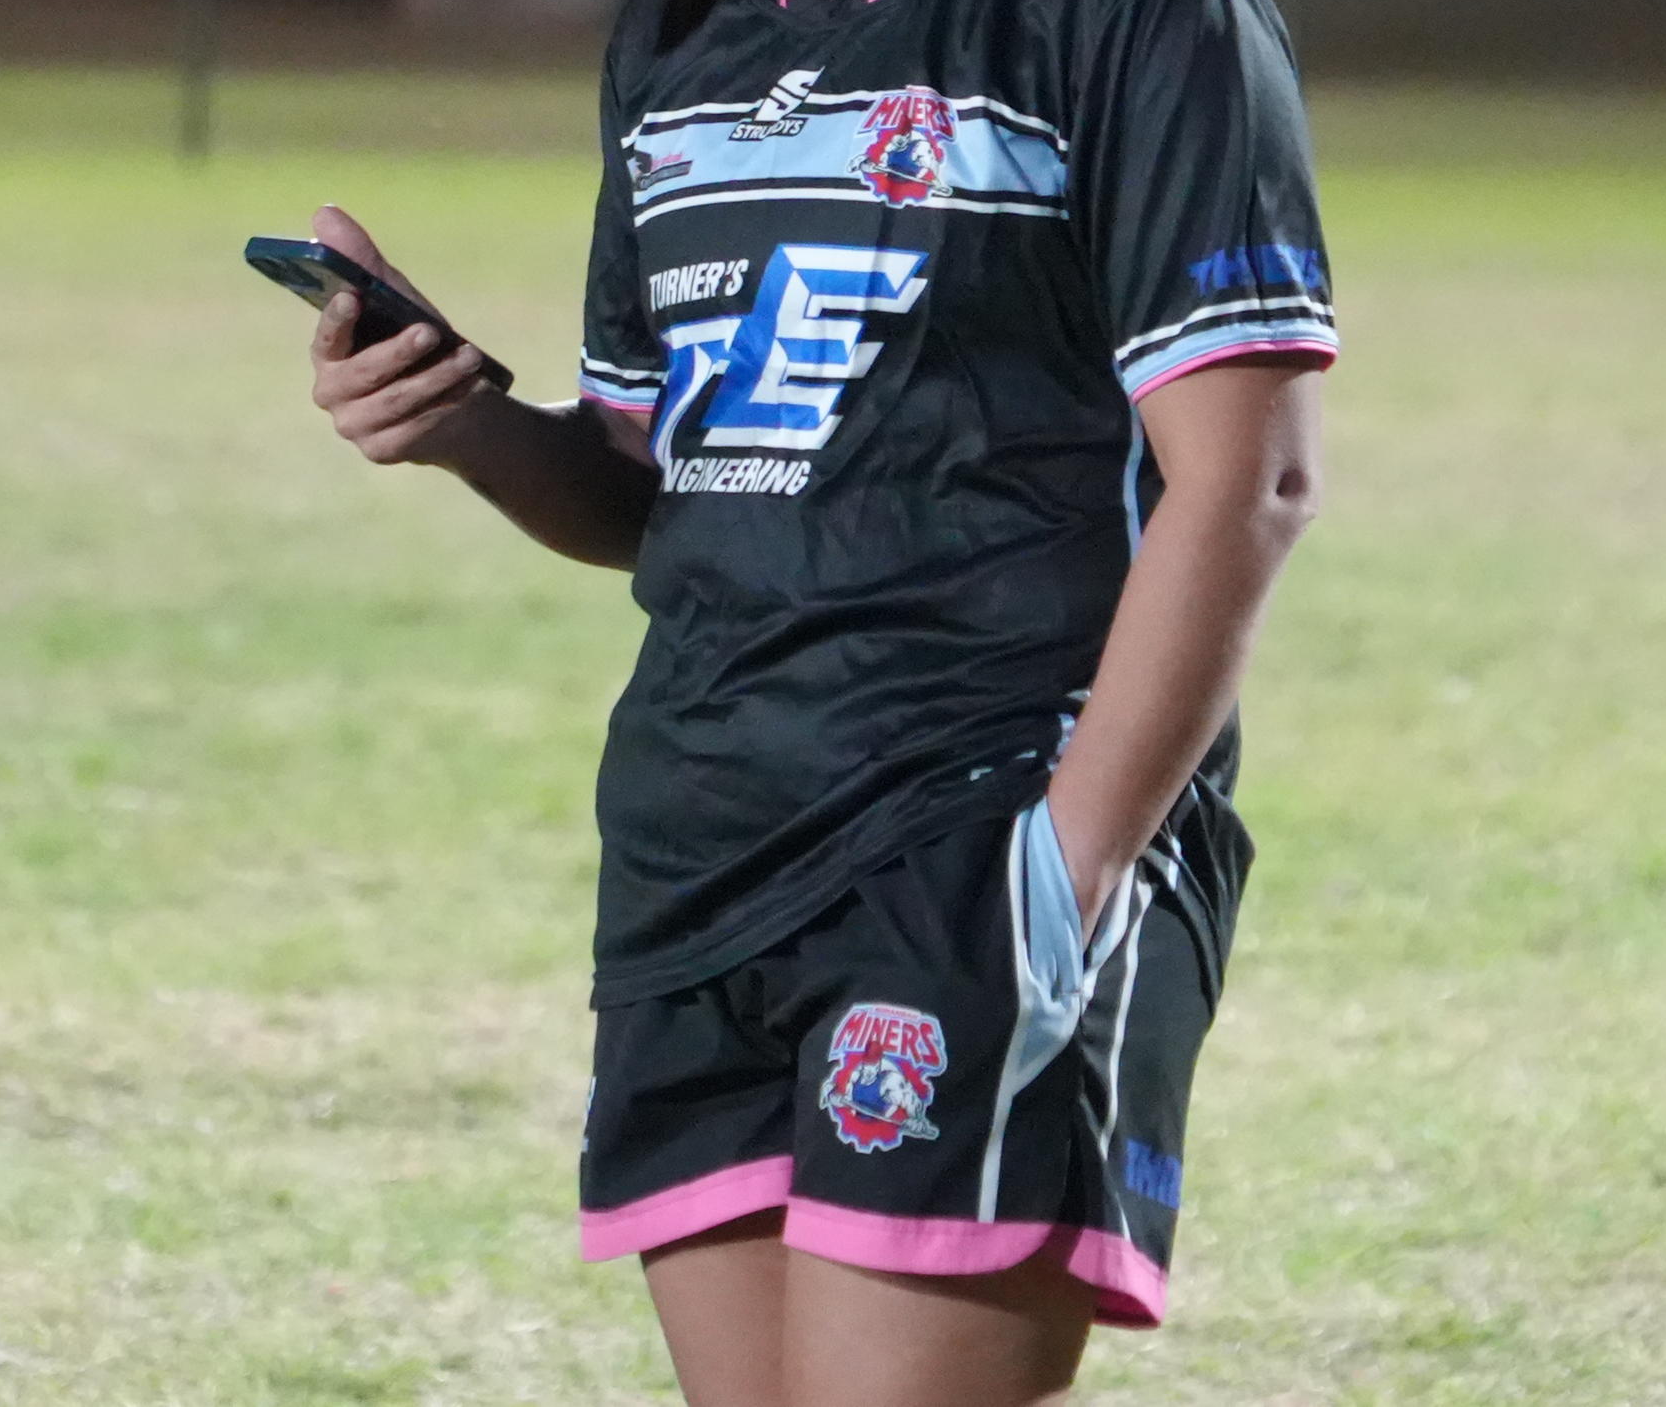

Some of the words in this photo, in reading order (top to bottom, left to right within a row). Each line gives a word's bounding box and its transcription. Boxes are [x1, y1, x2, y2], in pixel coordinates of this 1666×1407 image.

[649, 258, 749, 312] TURNER'S
[660, 458, 812, 496] NGINEERING
[833, 1011, 941, 1067] MINERS
